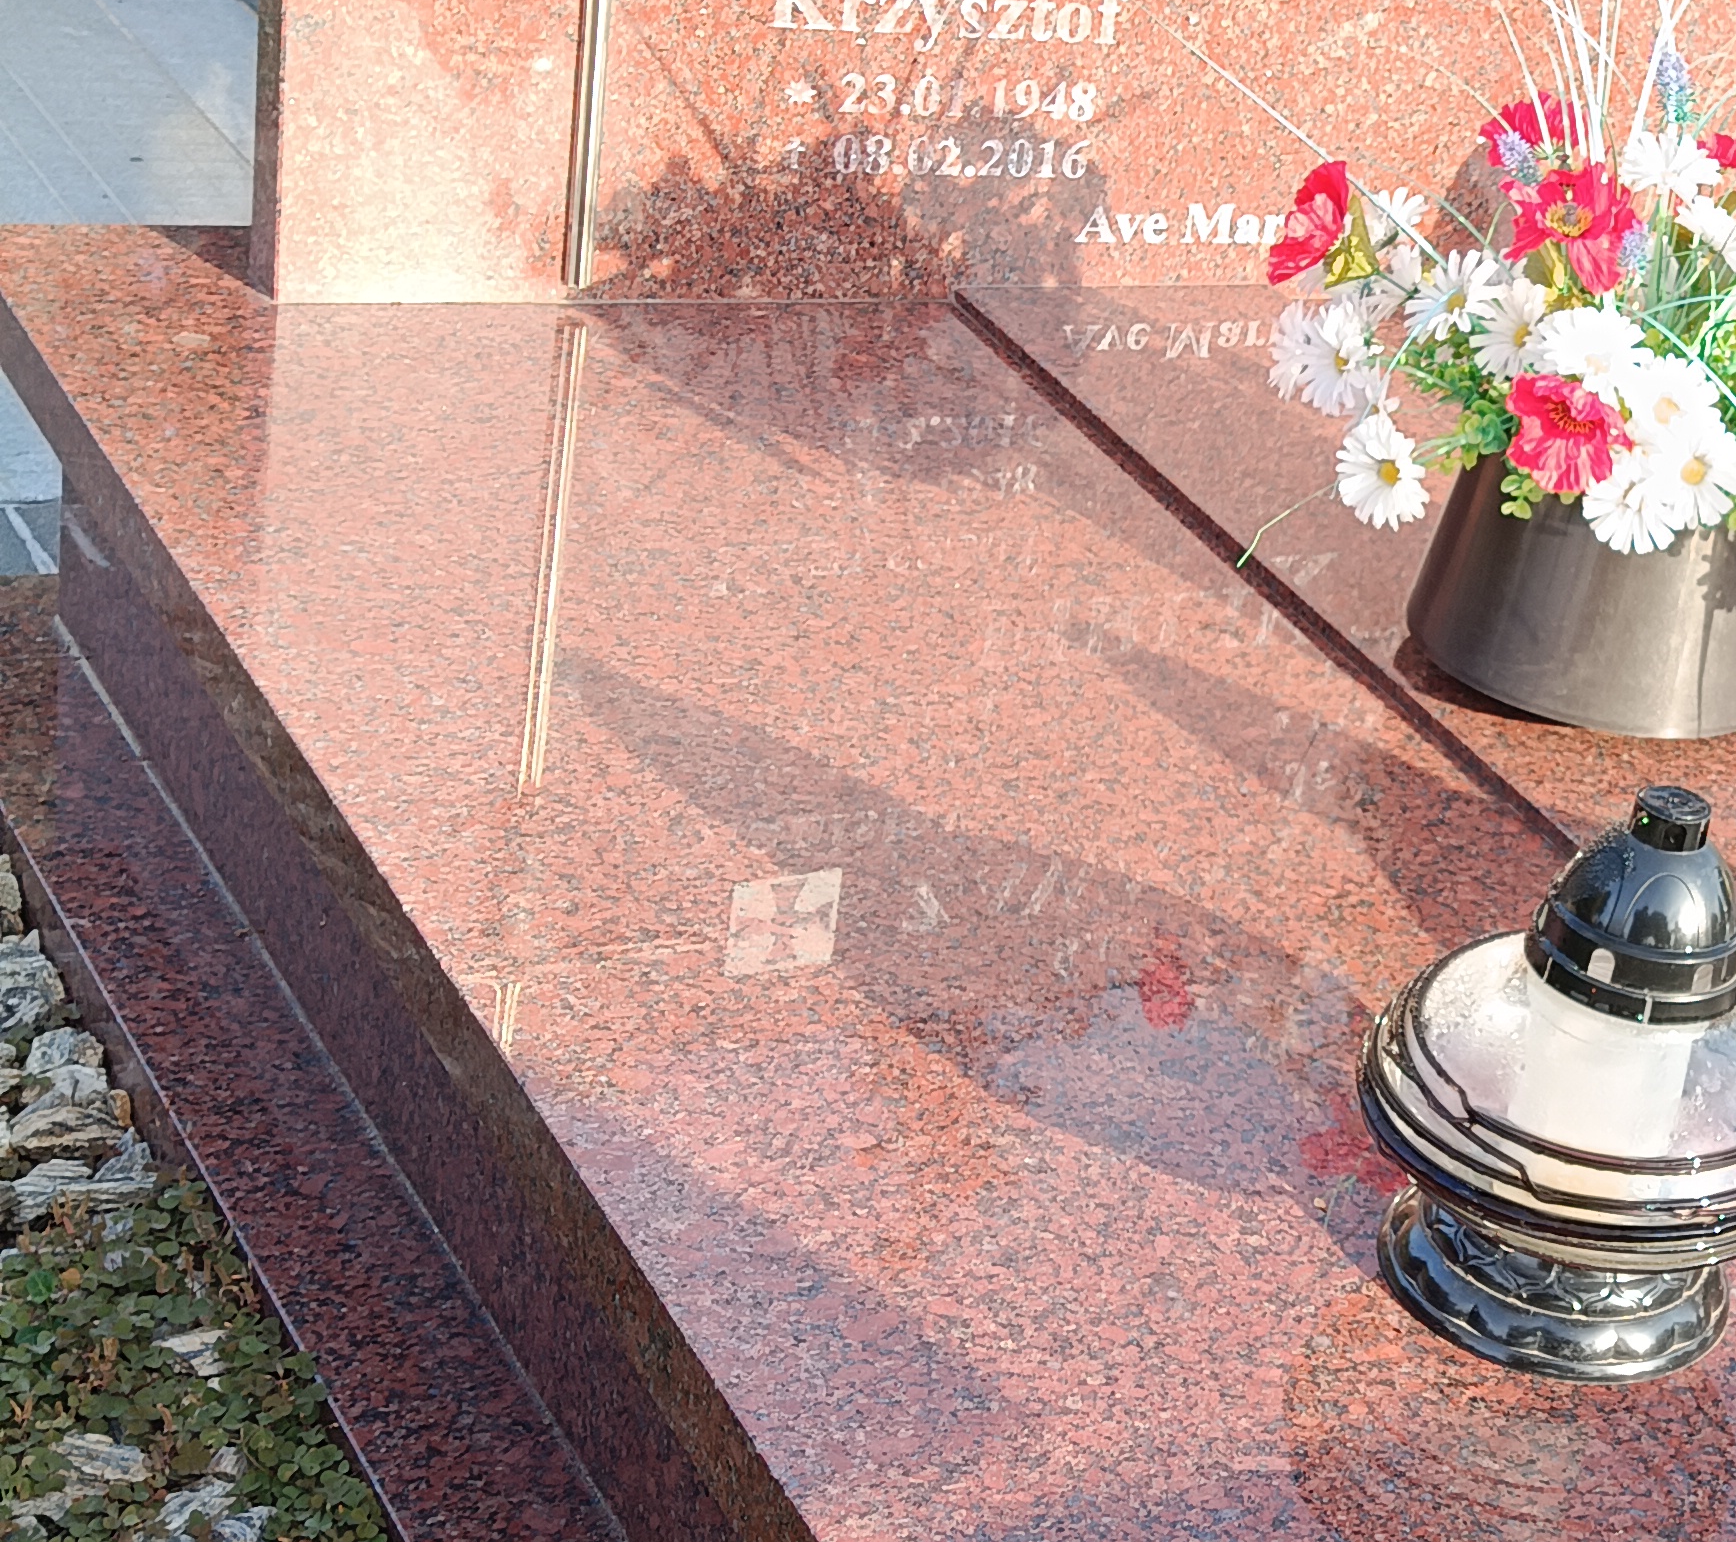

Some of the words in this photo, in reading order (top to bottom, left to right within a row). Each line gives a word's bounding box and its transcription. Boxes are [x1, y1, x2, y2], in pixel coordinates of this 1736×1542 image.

[838, 72, 1098, 122] 23.01.1948
[833, 134, 1092, 179] 08.02.2016
[1075, 204, 1168, 245] Ave
[1180, 203, 1286, 245] Mar
